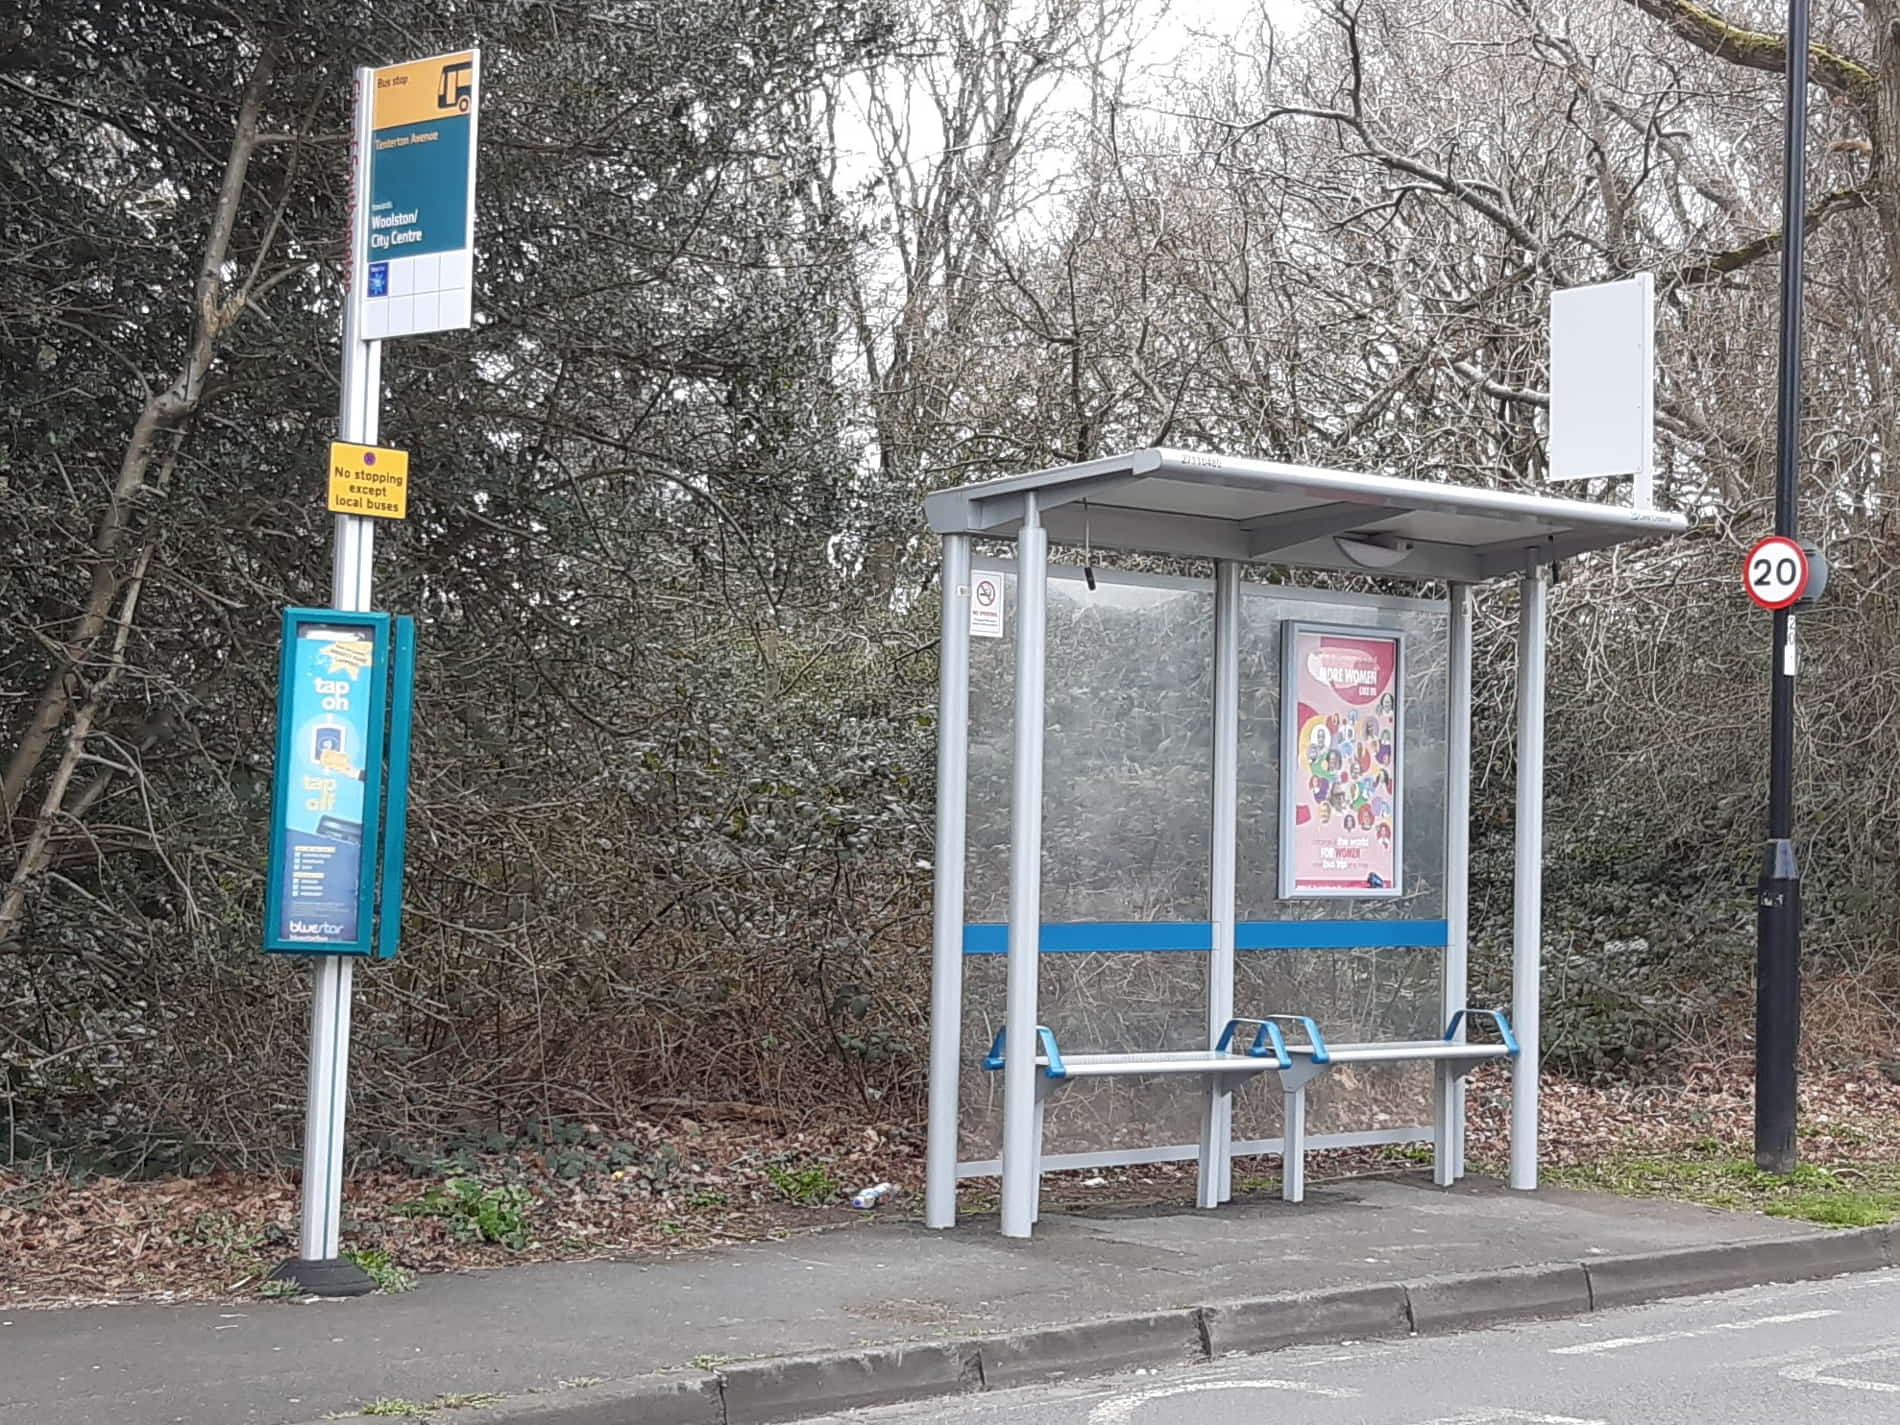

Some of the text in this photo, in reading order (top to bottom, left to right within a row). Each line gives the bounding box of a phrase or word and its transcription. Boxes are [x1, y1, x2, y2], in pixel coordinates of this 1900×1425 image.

[377, 76, 409, 89] Bus stop
[410, 131, 439, 145] Avenue
[371, 208, 419, 230] Woolston/
[371, 229, 423, 249] City Centre
[334, 466, 404, 487] No stopping
[349, 484, 387, 497] except
[335, 494, 399, 512] local buses
[1753, 557, 1797, 587] 20
[1344, 668, 1377, 685] WOMEN
[314, 677, 351, 697] tap
[321, 696, 350, 711] on
[303, 775, 337, 794] tap
[305, 789, 337, 811] off
[1335, 848, 1361, 858] WOMEN
